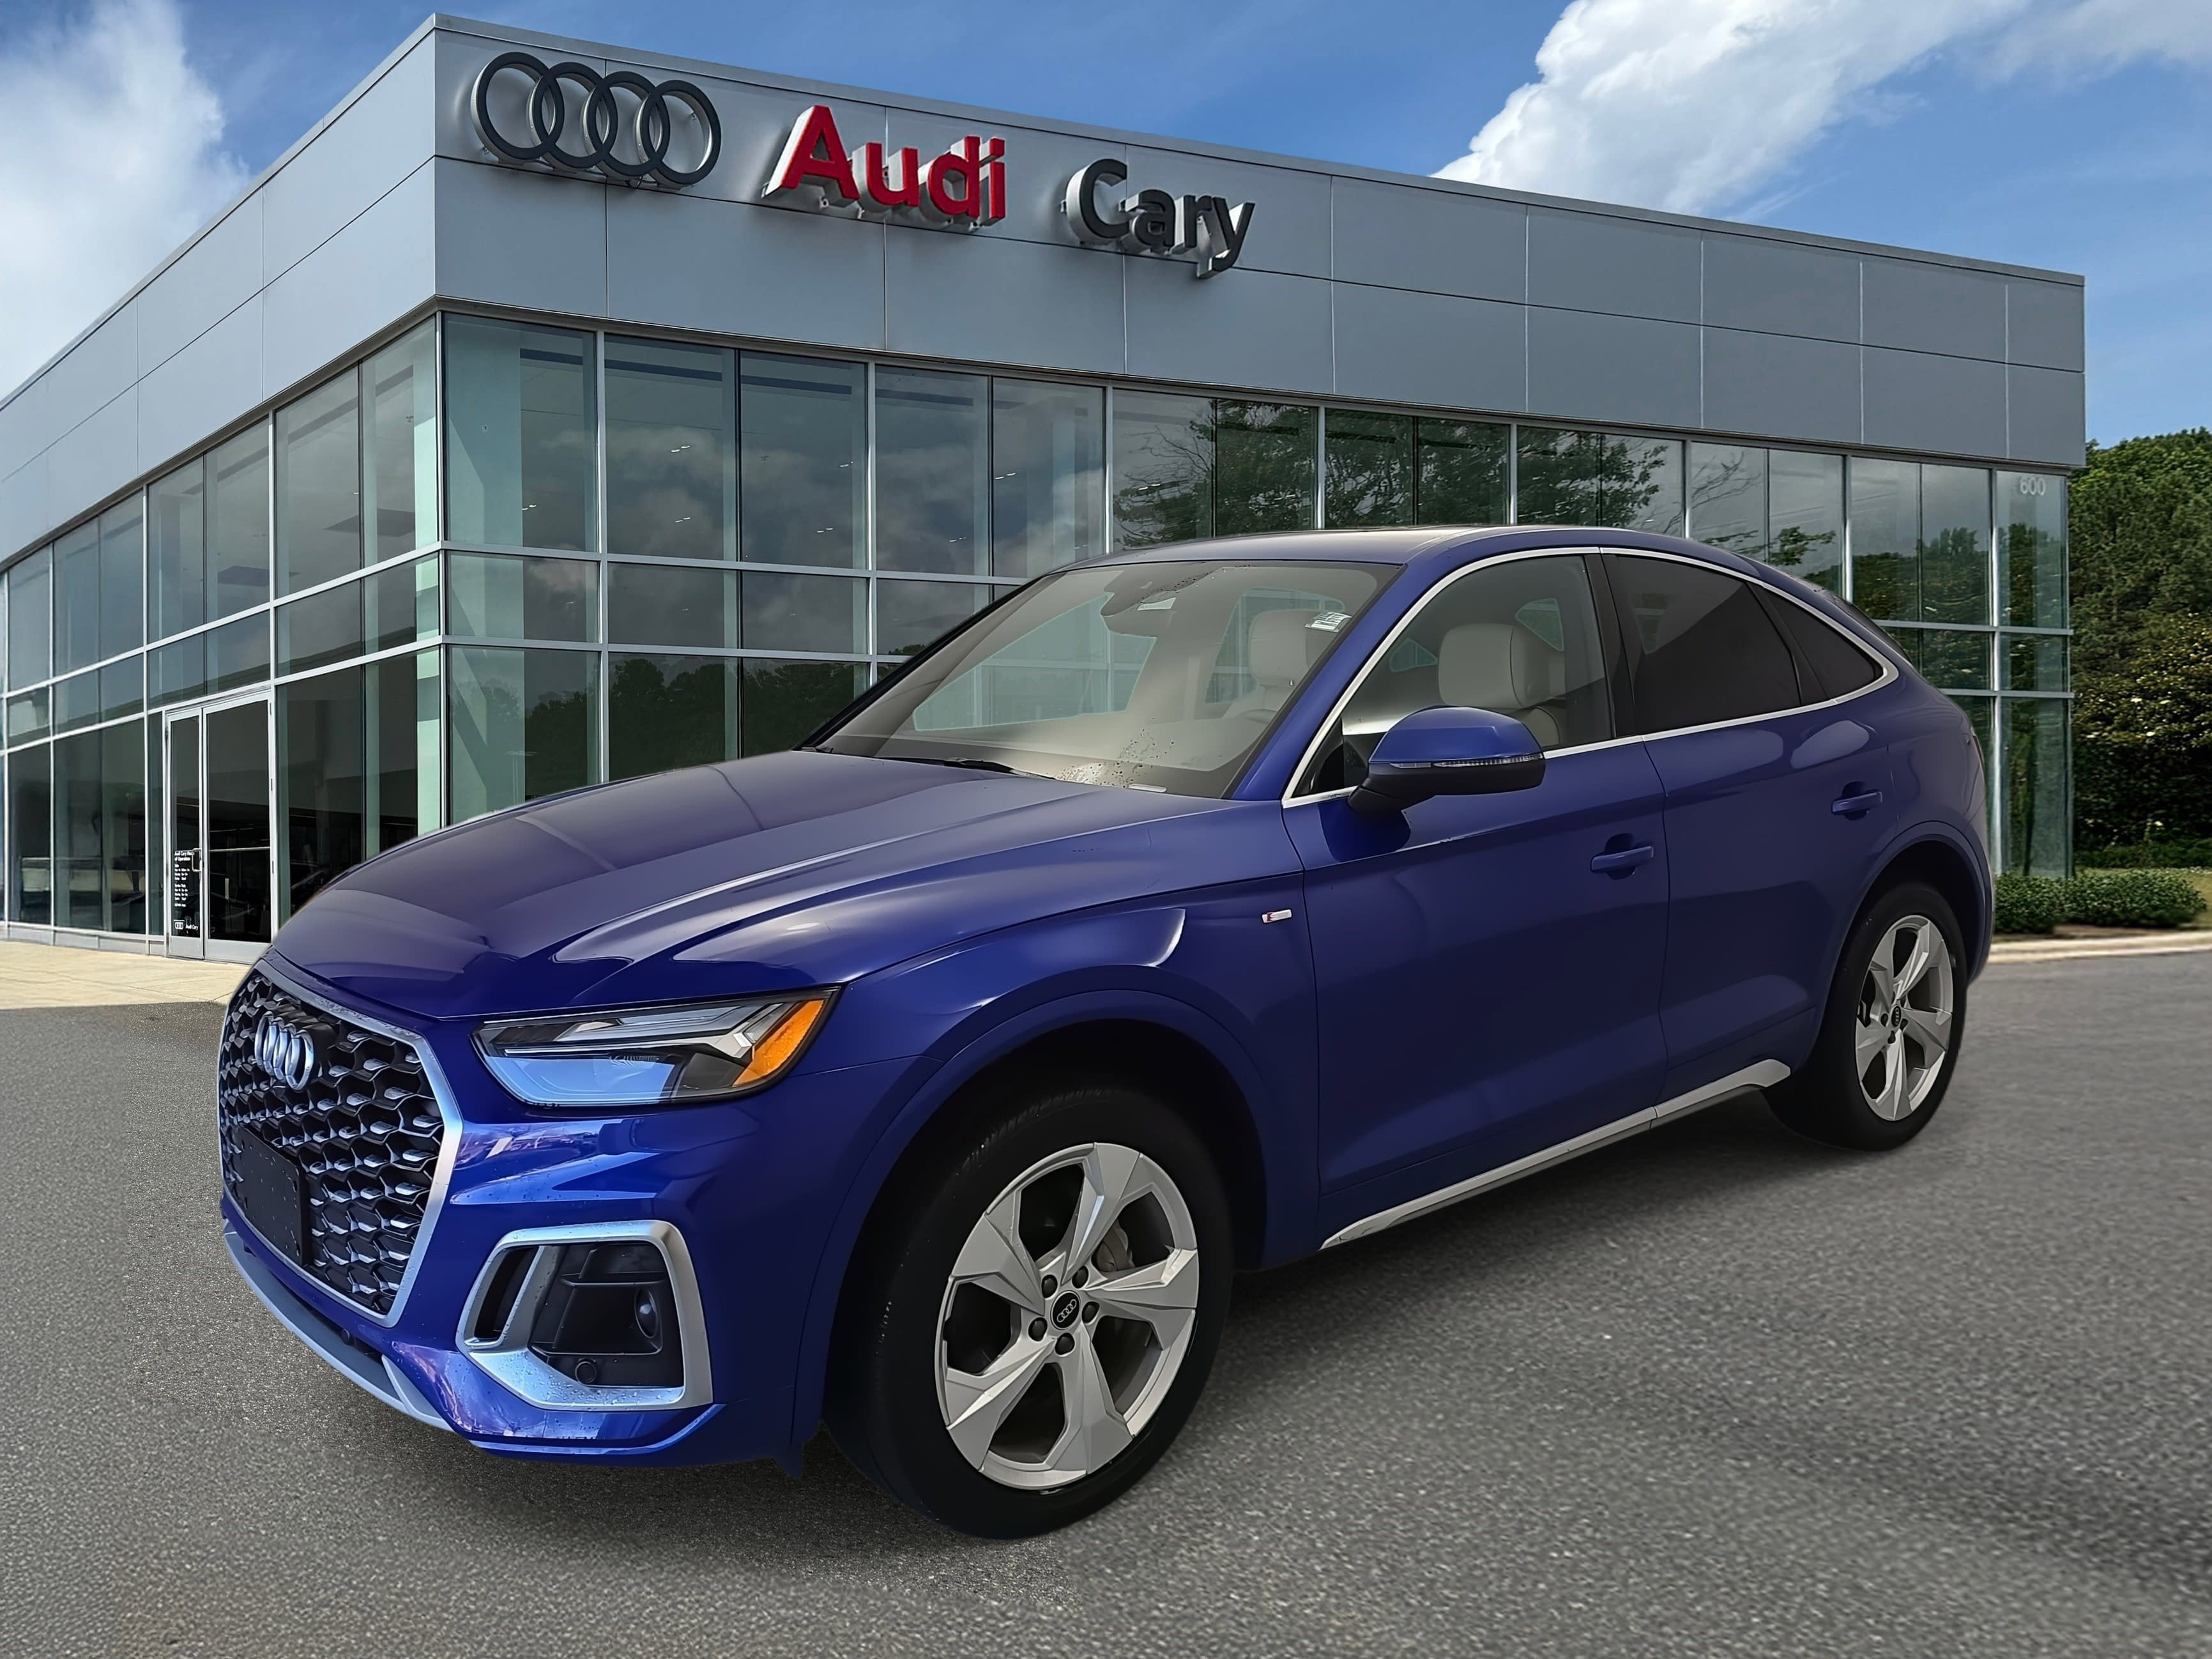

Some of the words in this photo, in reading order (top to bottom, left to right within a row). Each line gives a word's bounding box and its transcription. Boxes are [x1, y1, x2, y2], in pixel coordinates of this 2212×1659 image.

[767, 105, 1005, 220] Audi
[1068, 158, 1256, 276] Cary
[2019, 477, 2045, 496] 600
